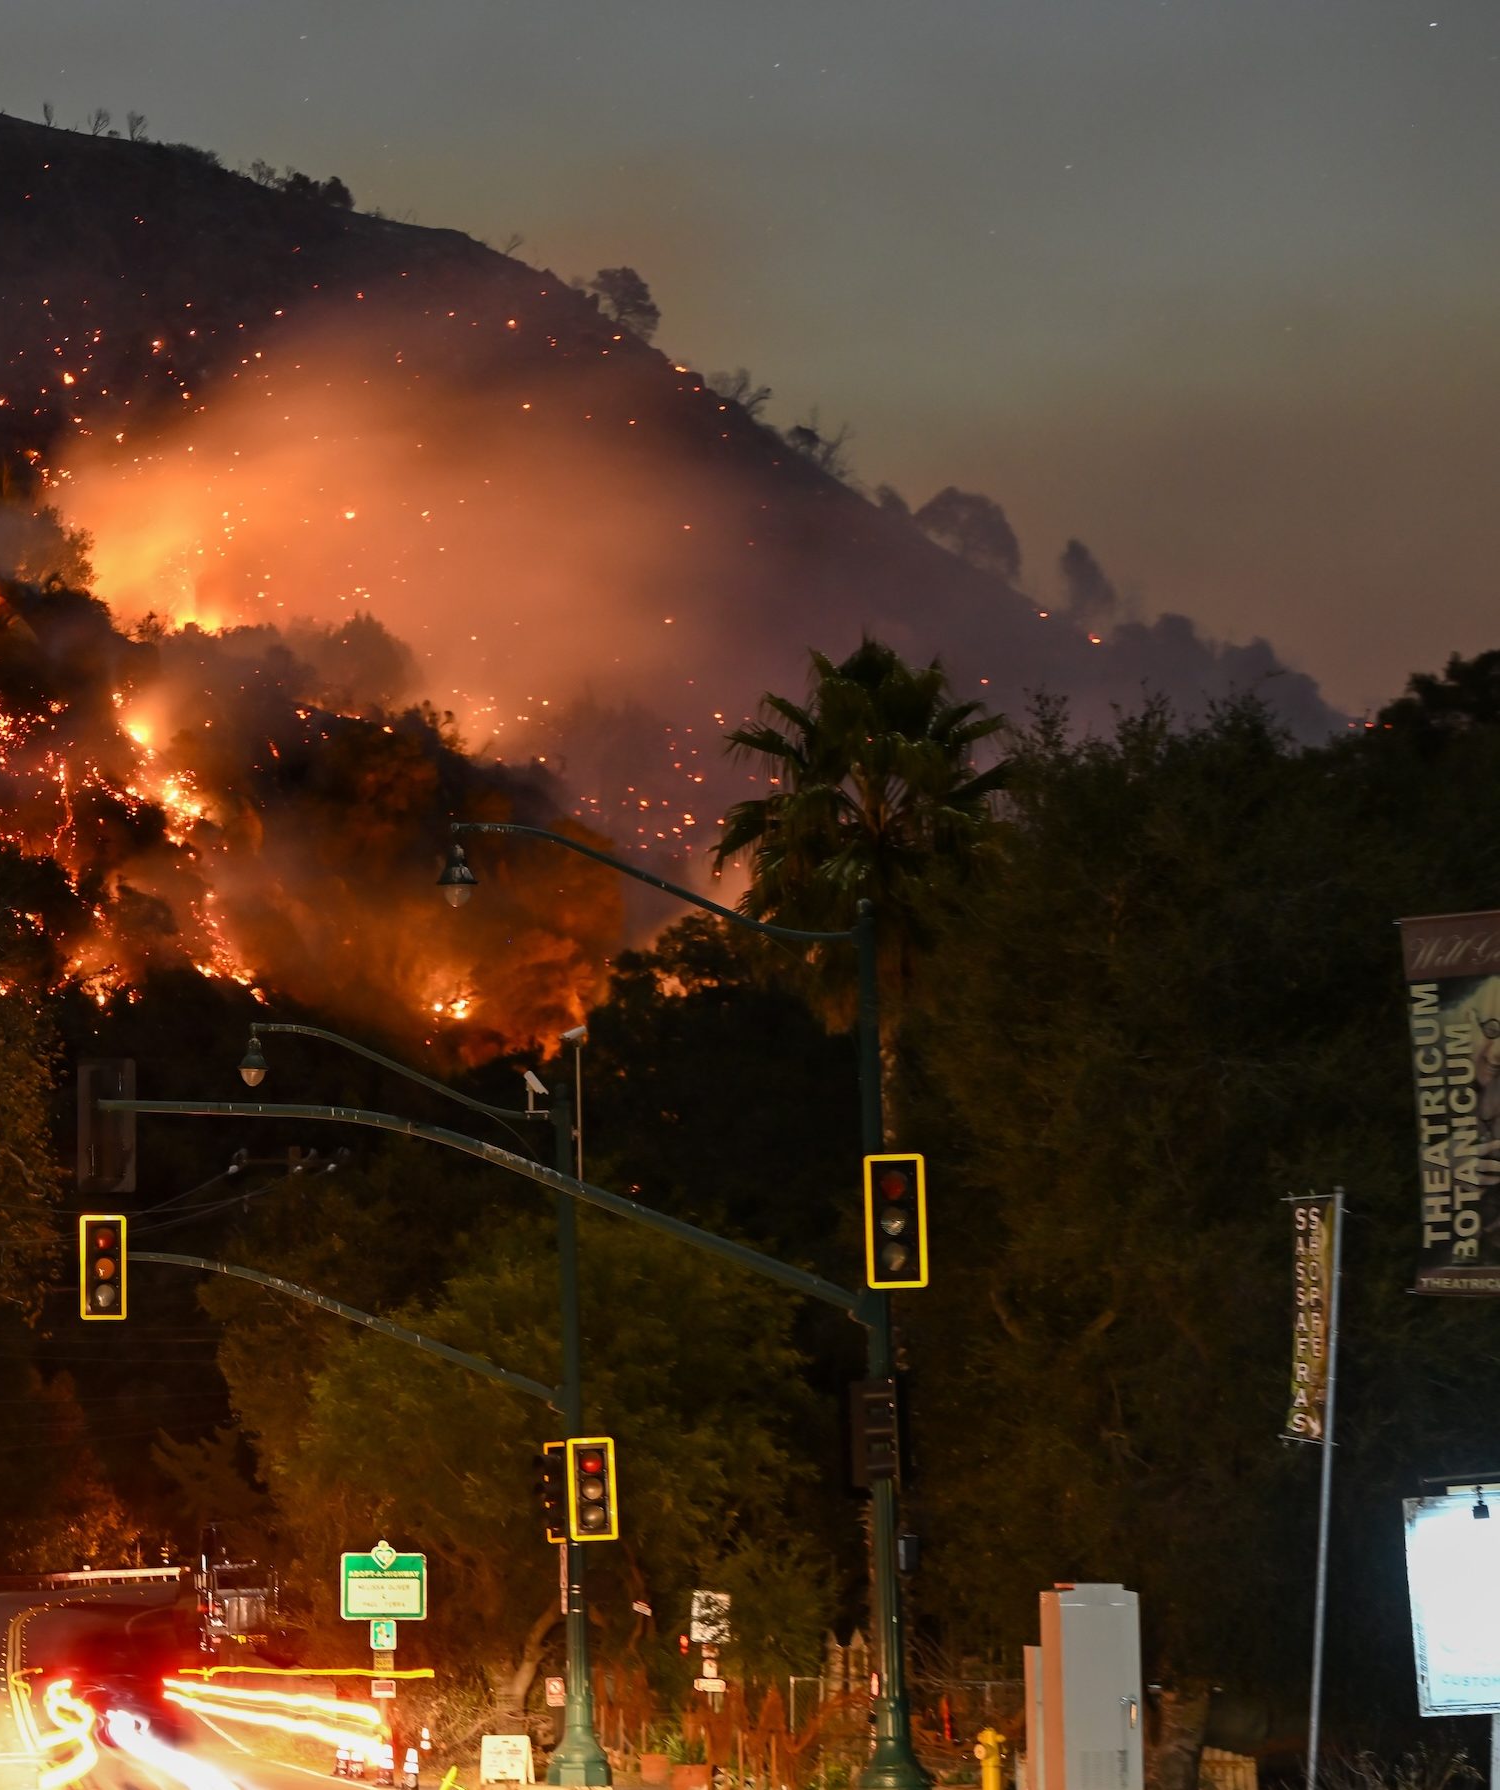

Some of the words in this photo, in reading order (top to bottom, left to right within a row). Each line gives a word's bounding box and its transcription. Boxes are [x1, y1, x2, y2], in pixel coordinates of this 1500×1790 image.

[1410, 982, 1451, 1249] THEATRICUM
[1445, 1024, 1480, 1264] BOTANICUM
[1293, 1206, 1310, 1433] SASSAFRAS
